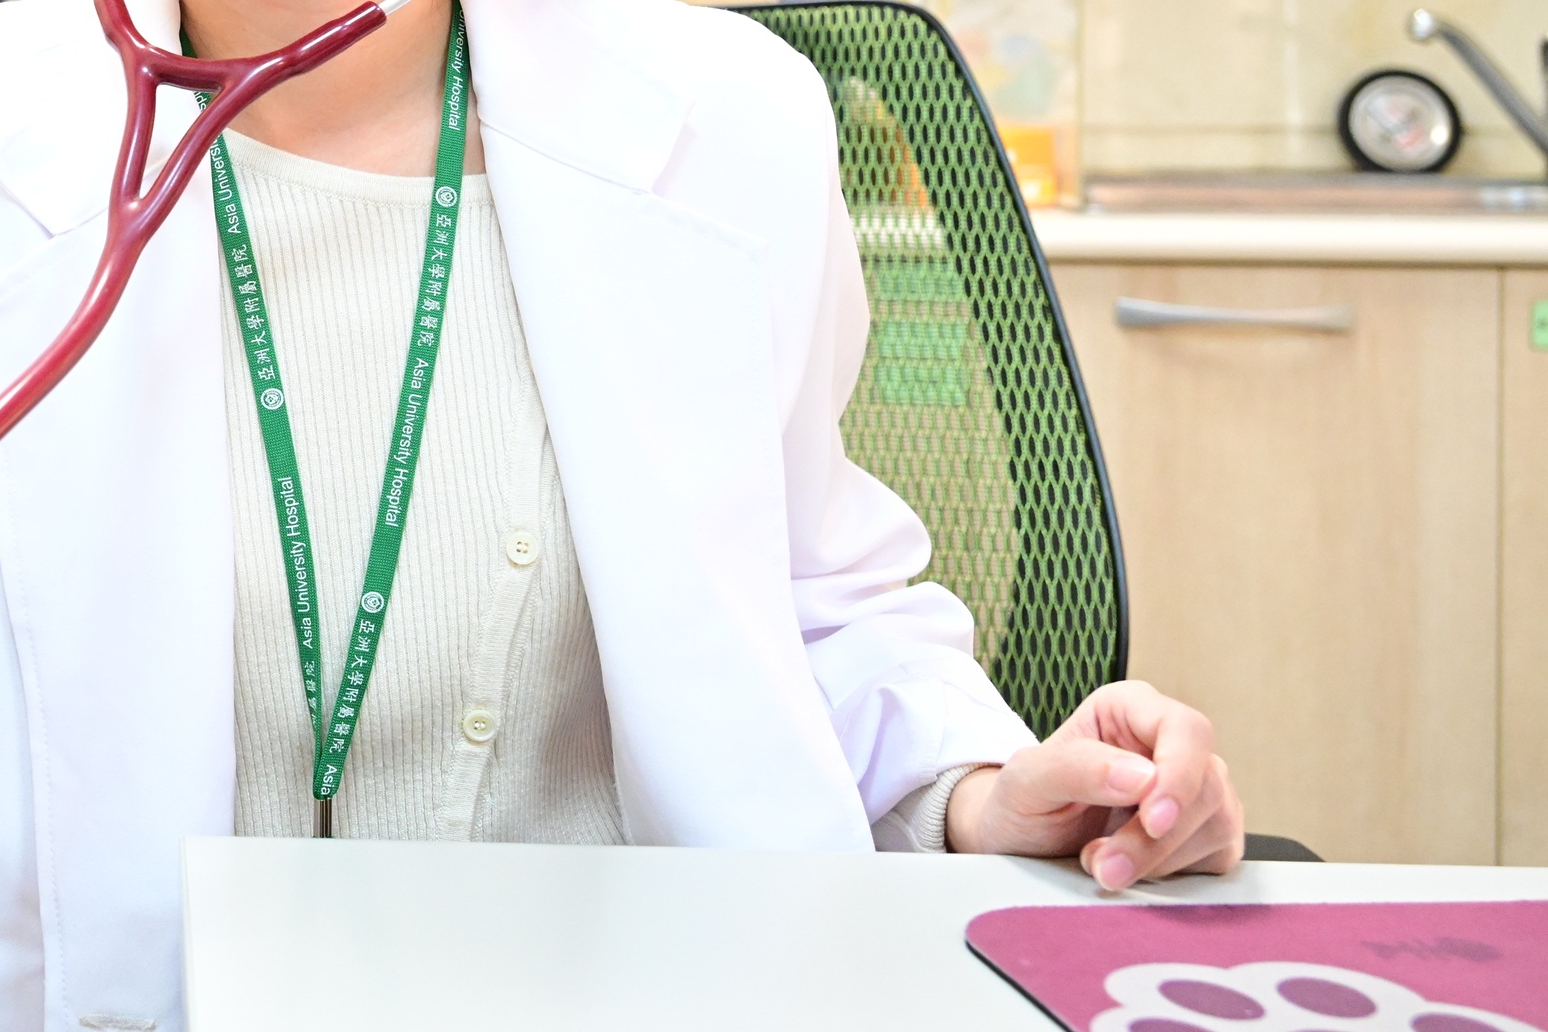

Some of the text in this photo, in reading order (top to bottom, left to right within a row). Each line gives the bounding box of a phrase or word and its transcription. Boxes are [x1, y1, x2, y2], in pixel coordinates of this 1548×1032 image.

[448, 75, 464, 131] Hospital
[210, 135, 233, 201] Universi
[225, 203, 242, 234] Asia
[417, 213, 452, 347] 亞洲大學附屬醫院
[232, 244, 276, 381] 亞洲大學附屬醫院
[411, 357, 429, 389] Asia
[394, 393, 423, 465] University
[278, 476, 301, 537] Hospital
[385, 468, 409, 528] Hospital
[290, 541, 311, 613] University
[301, 617, 314, 649] Asia
[329, 618, 376, 754] 亞洲大學附屬醫院
[320, 764, 338, 796] Asia
